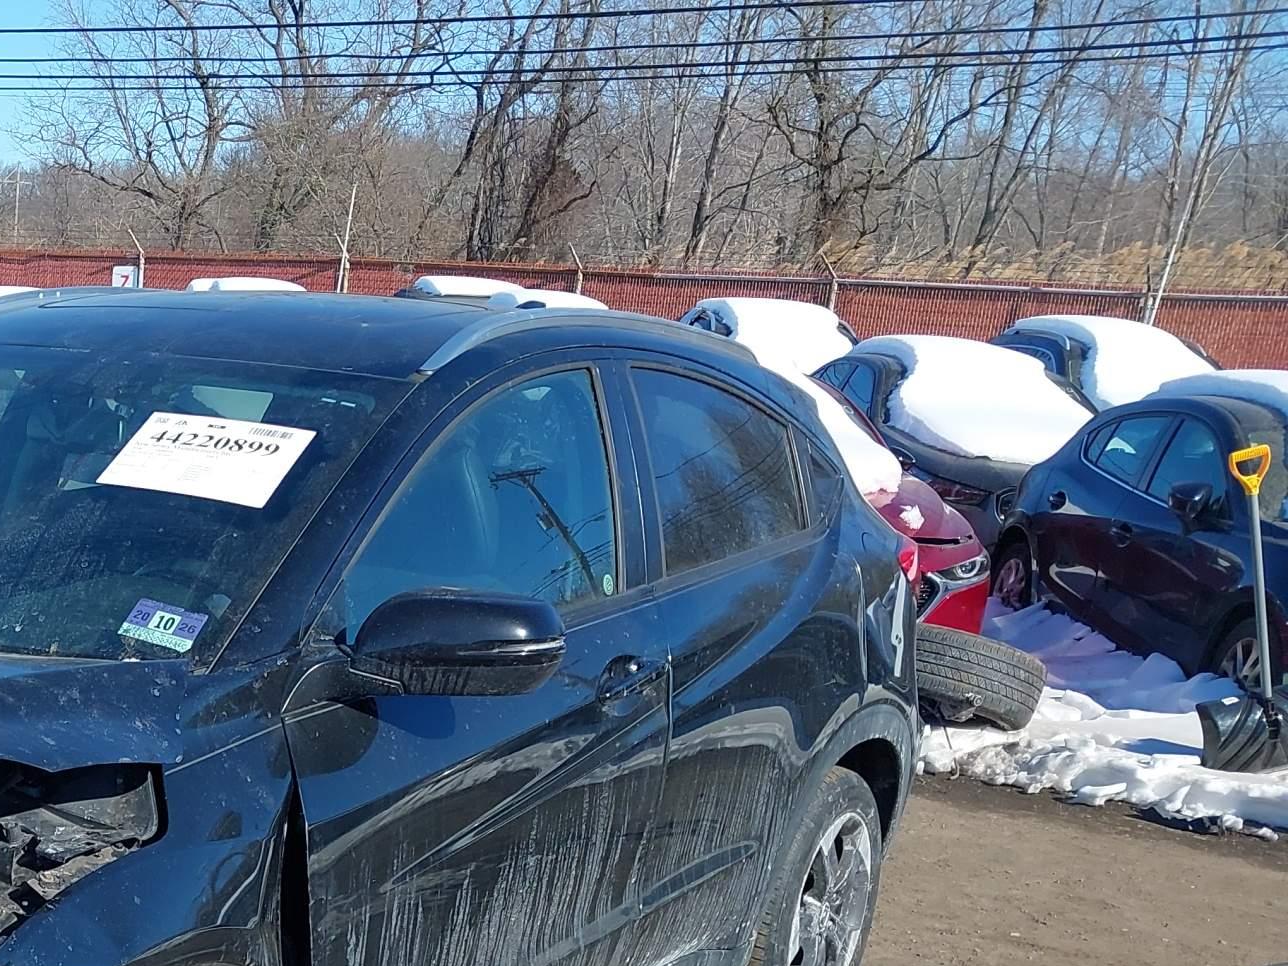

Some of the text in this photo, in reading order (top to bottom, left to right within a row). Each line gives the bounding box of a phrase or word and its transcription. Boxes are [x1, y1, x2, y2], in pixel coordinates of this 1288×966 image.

[150, 430, 280, 457] 44220899
[133, 609, 151, 622] 20
[154, 615, 176, 631] 10
[178, 623, 197, 634] 26
